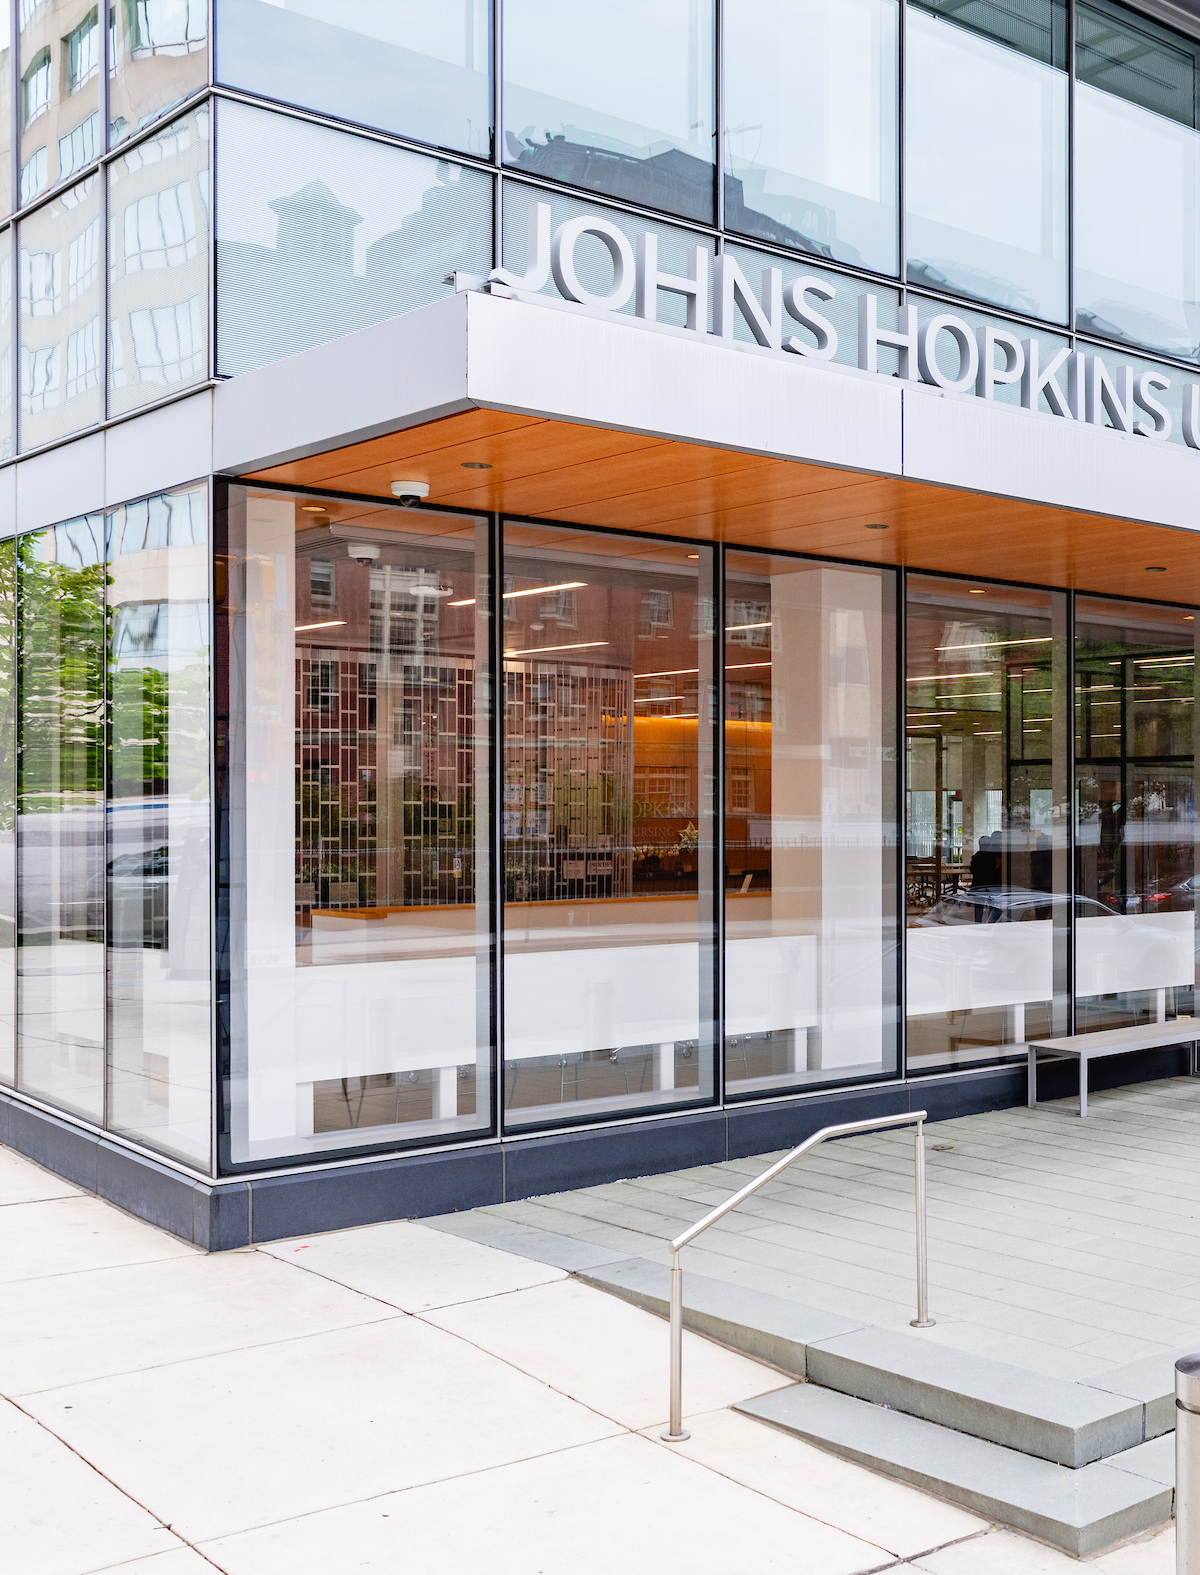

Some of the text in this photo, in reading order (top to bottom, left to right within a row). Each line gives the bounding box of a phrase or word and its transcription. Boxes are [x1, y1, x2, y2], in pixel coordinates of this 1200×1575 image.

[488, 202, 837, 361] JOHNS
[858, 293, 1172, 442] HOPKINS
[632, 801, 695, 819] OPKINS
[633, 826, 675, 838] URSING
